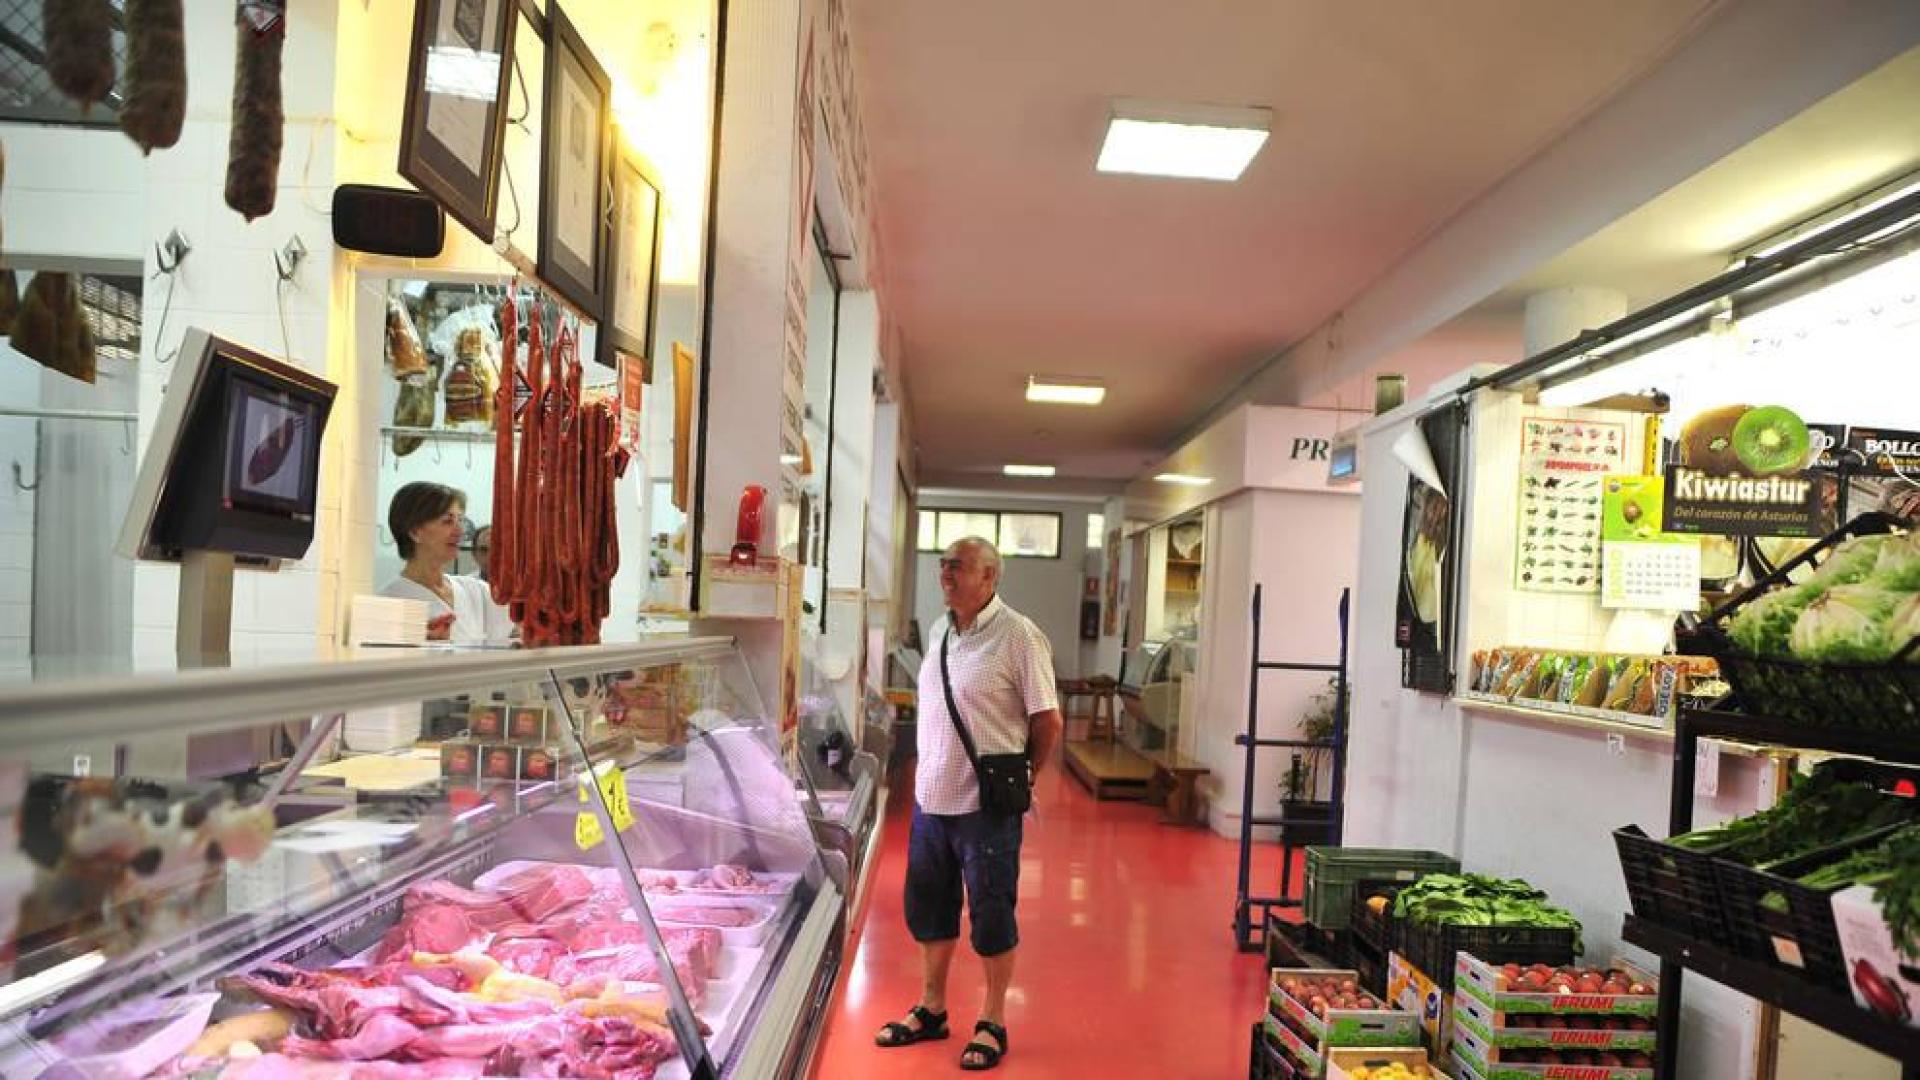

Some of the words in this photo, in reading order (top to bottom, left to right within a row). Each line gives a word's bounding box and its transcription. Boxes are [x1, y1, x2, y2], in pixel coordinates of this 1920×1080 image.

[1674, 467, 1811, 504] Kiwiastur
[1674, 505, 1694, 518] Del
[1743, 509, 1757, 520] de
[1760, 509, 1808, 523] Asturias
